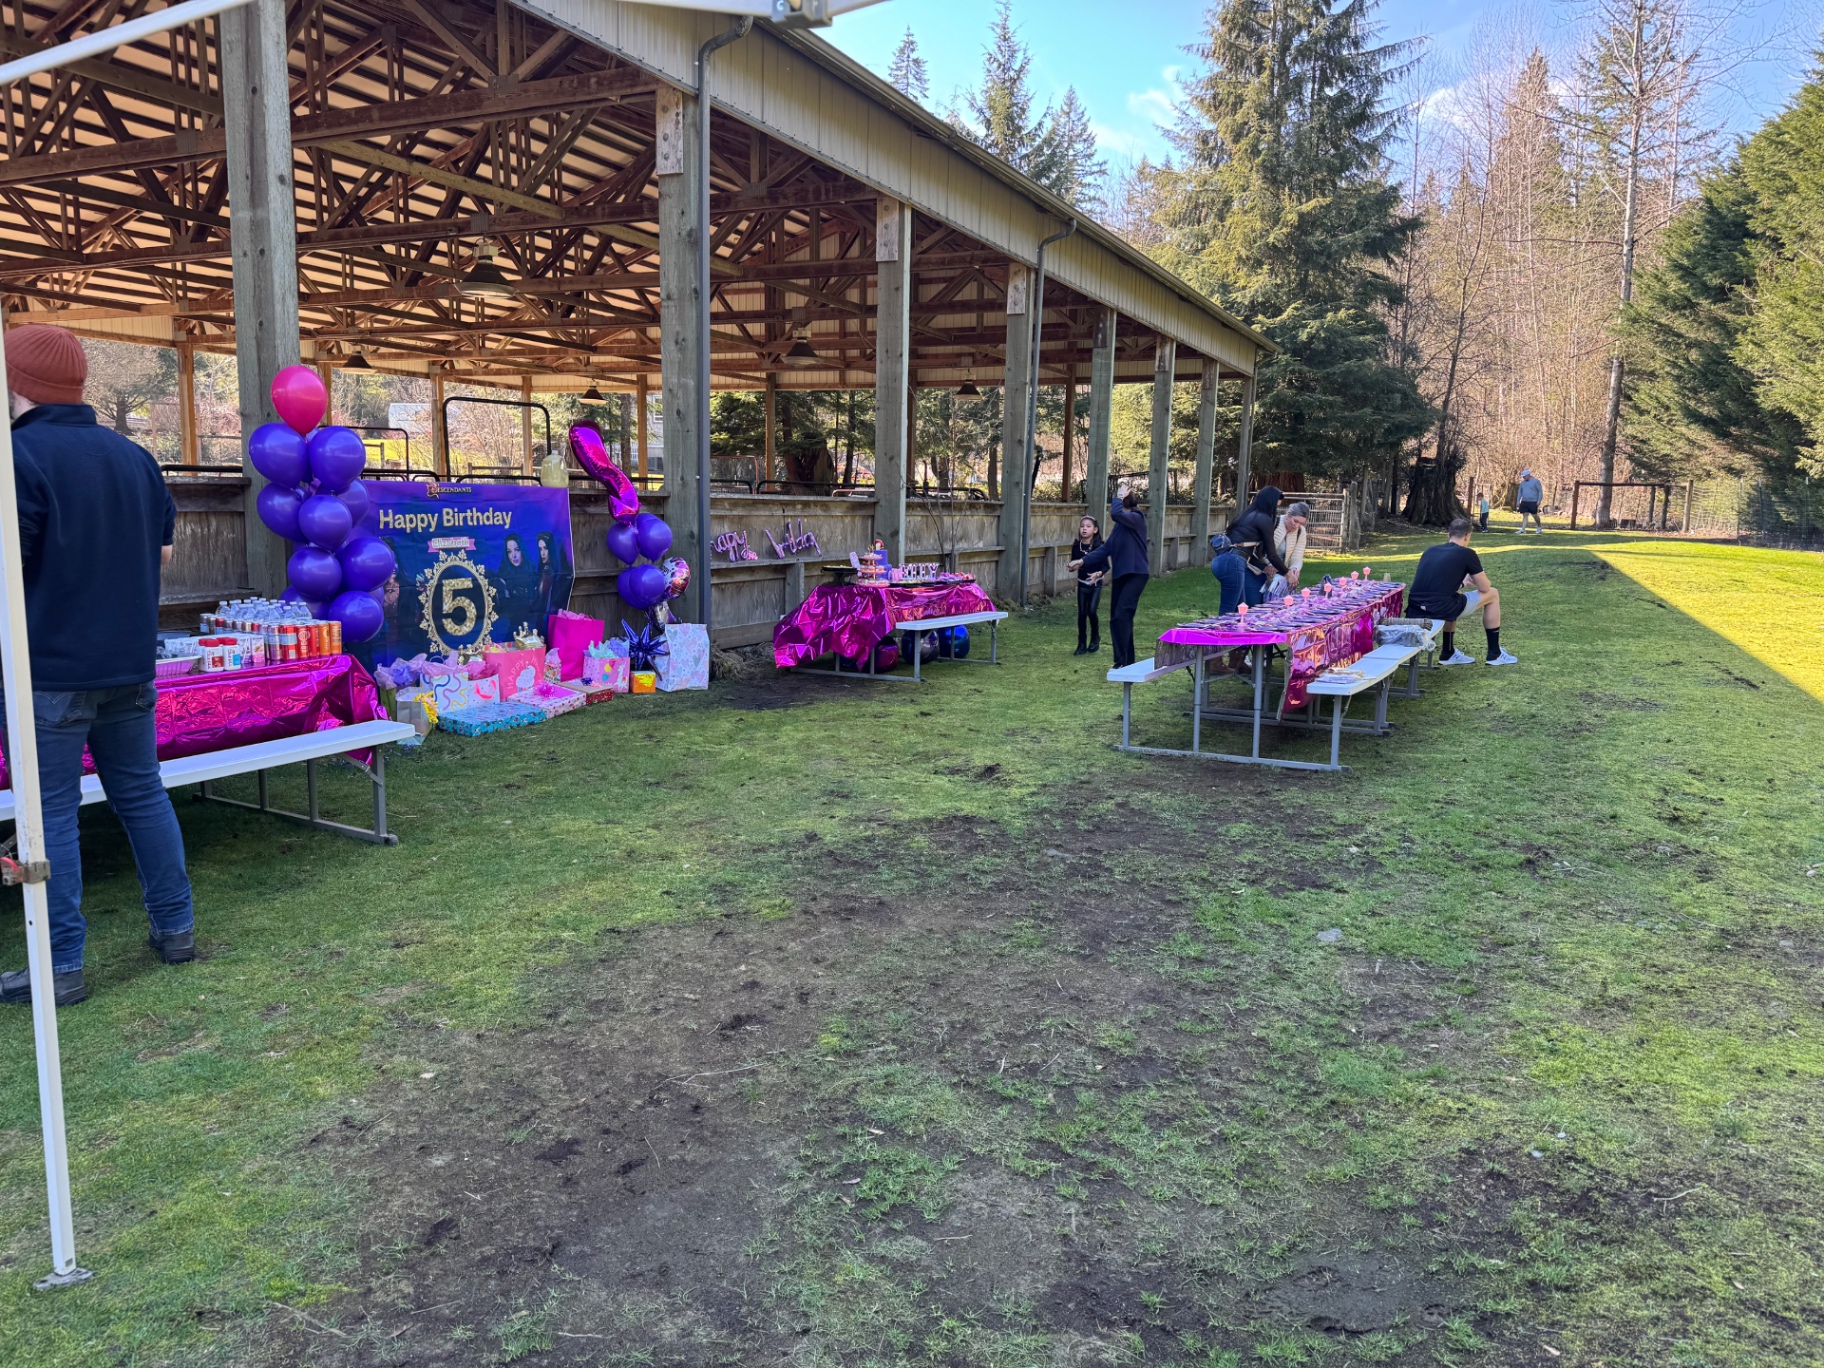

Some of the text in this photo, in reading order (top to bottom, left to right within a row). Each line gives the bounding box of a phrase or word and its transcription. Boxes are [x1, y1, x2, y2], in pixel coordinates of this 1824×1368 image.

[379, 507, 512, 533] Happy Birthday
[441, 577, 477, 636] 5
[507, 659, 525, 689] HAPPY
